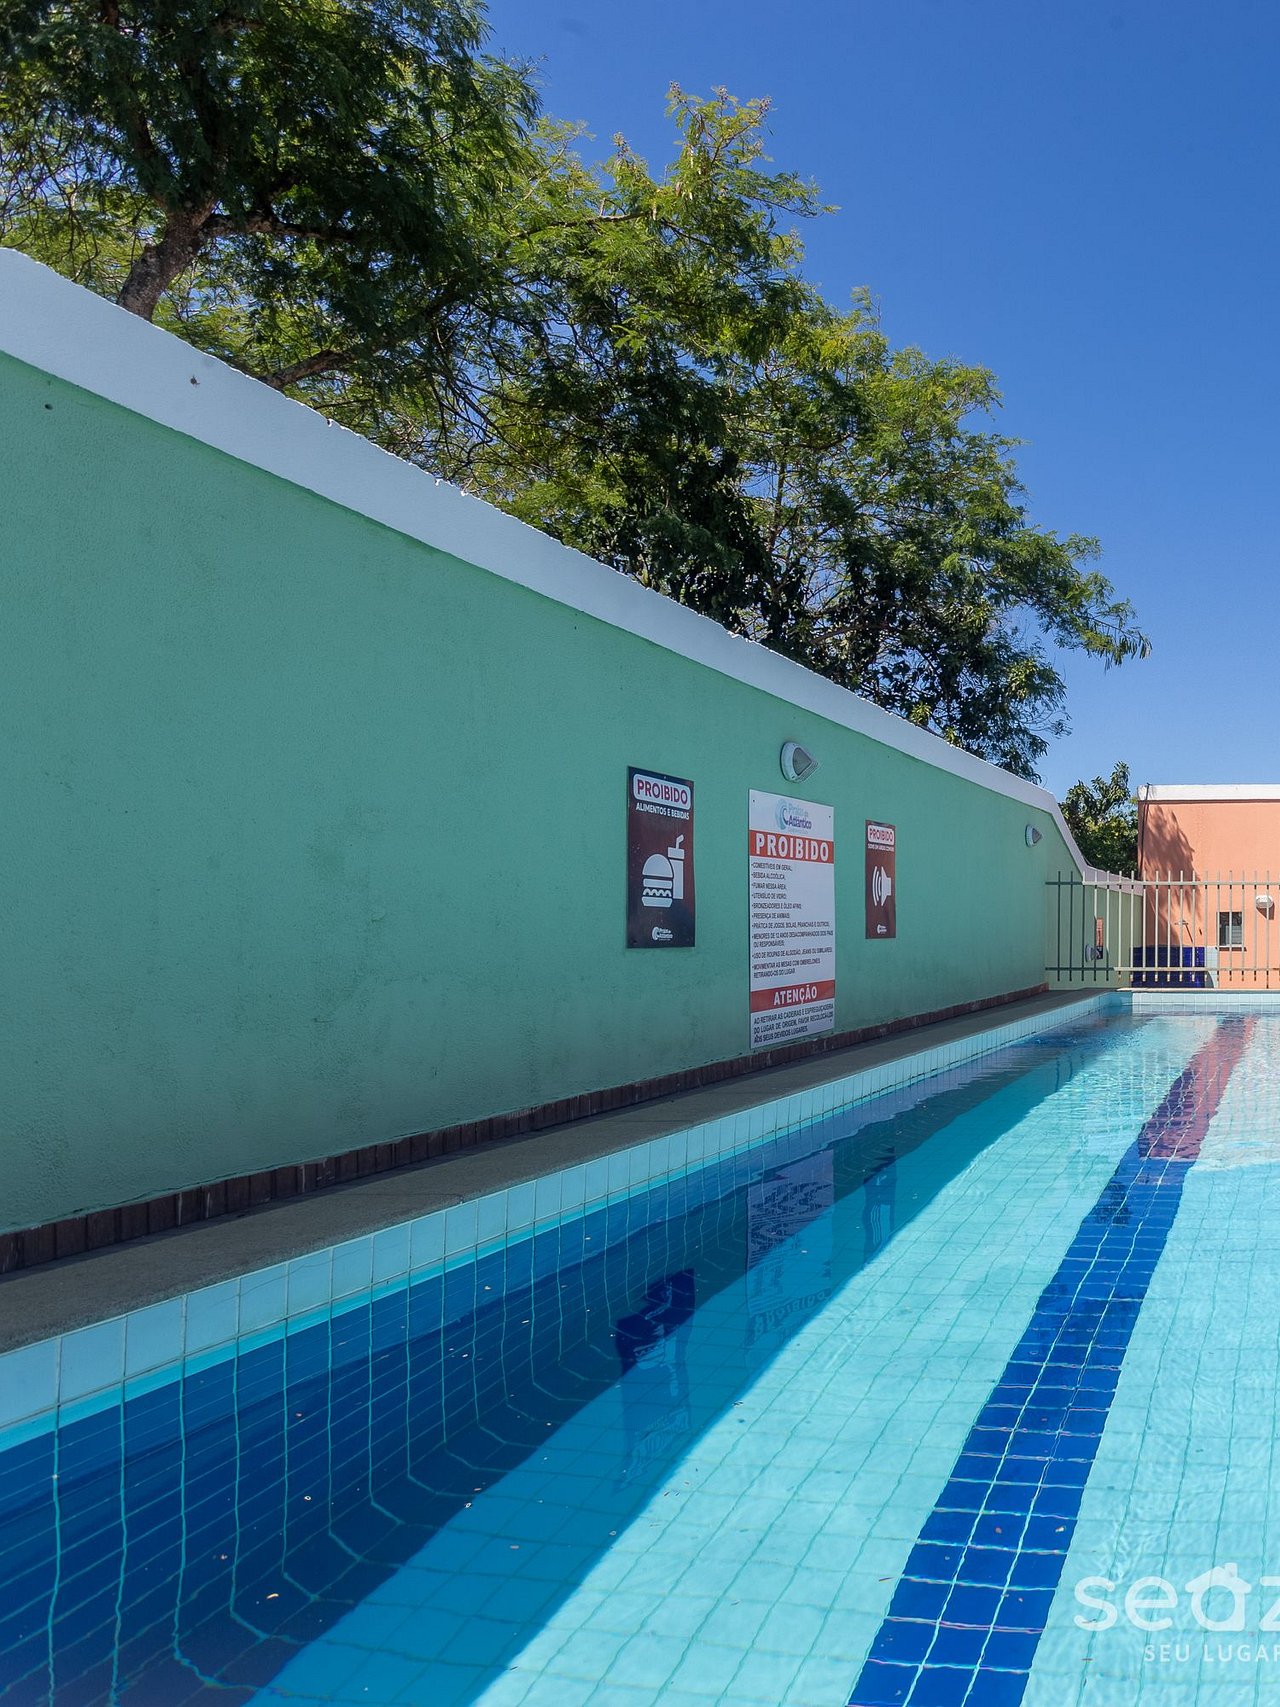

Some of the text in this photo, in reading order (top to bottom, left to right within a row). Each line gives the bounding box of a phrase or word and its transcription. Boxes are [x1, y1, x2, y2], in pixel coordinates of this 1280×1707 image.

[637, 779, 688, 805] PROIBIDO
[636, 802, 690, 821] ALIMENTOS E BEBIDAS
[869, 827, 894, 842] PROIBIDO
[755, 833, 829, 862] PROIBIDO
[773, 984, 818, 1006] ATENÇÃO
[753, 1027, 760, 1035] DO
[761, 1023, 775, 1033] LUGAR
[798, 1015, 810, 1025] FAVOR
[761, 1014, 778, 1023] RETIRAR
[784, 1009, 801, 1019] CADEIRAS
[763, 1032, 774, 1042] SEUS
[774, 1029, 791, 1040] DEVIDOS
